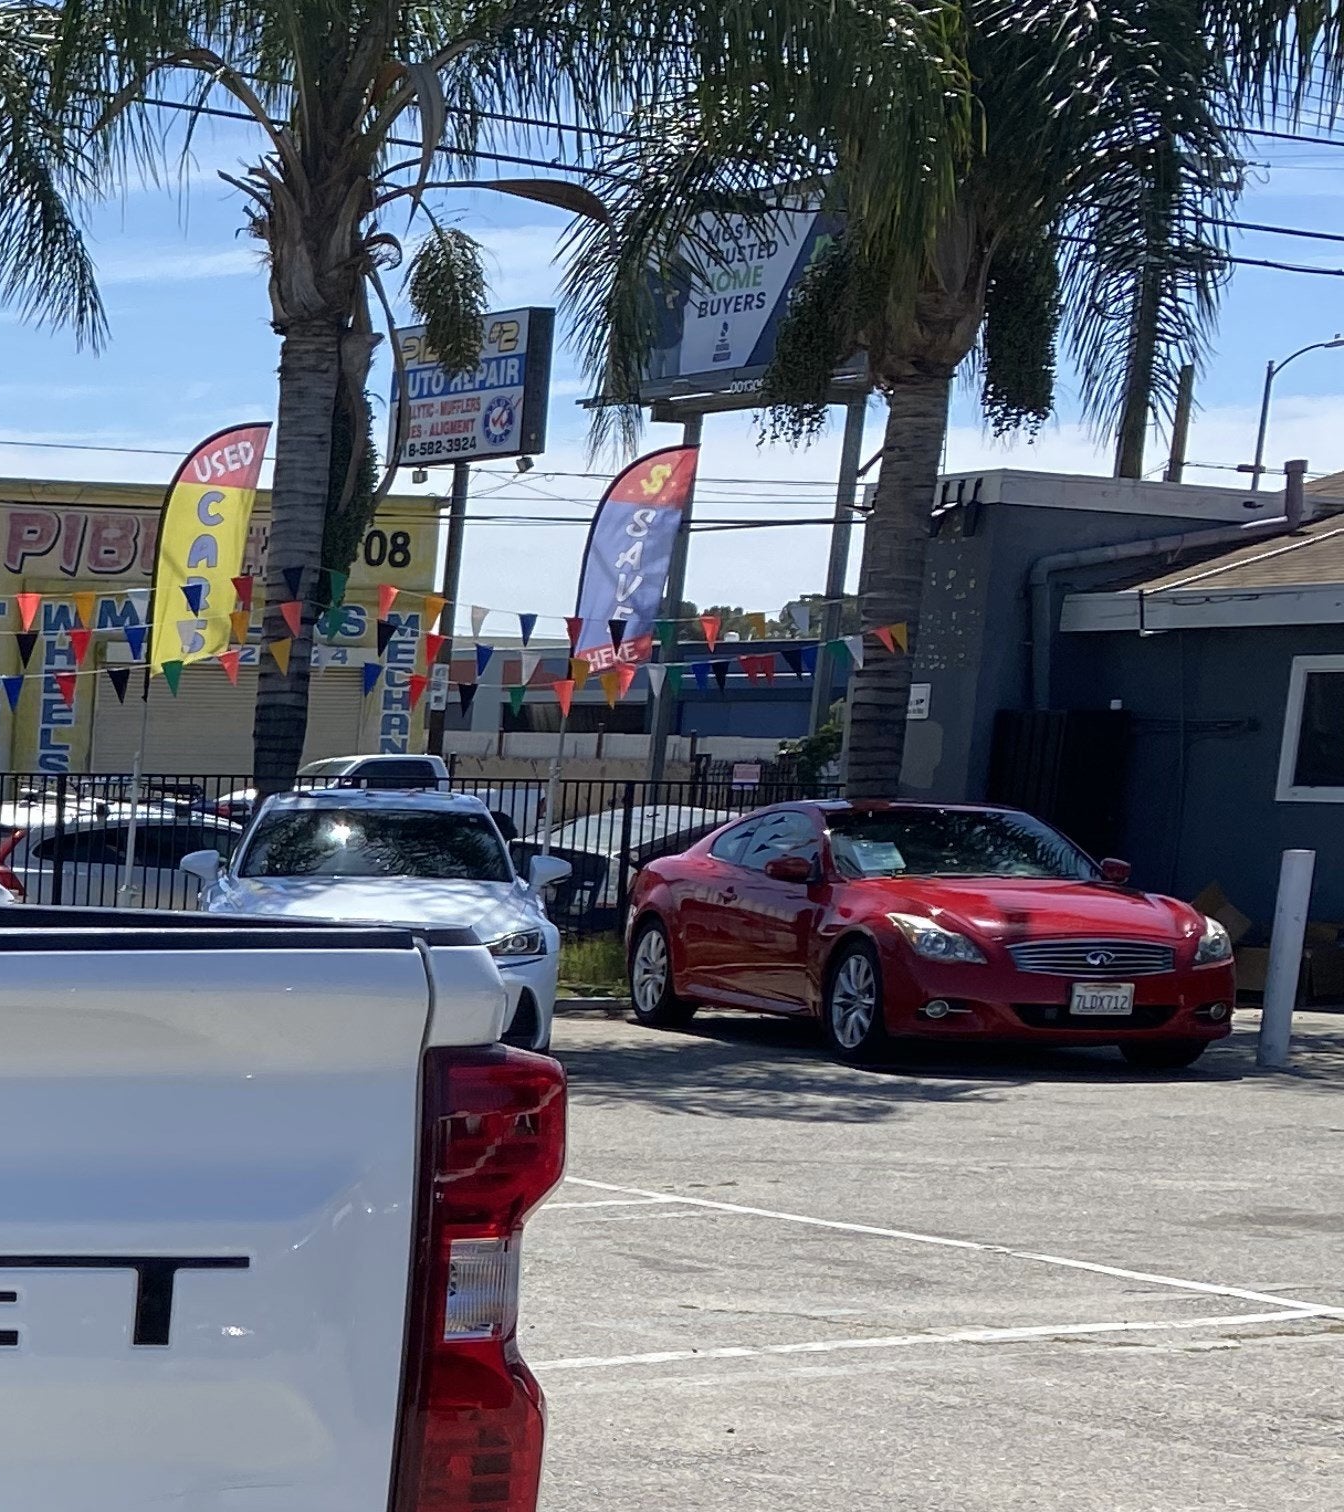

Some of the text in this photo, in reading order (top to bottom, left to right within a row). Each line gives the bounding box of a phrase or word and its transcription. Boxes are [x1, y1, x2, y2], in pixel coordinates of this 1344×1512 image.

[698, 292, 766, 319] BUYERS
[488, 320, 520, 352] #2
[393, 370, 446, 400] UTO
[440, 397, 482, 416] MUFFLERS
[193, 440, 255, 483] USED
[1075, 994, 1129, 1010] 7LDX712
